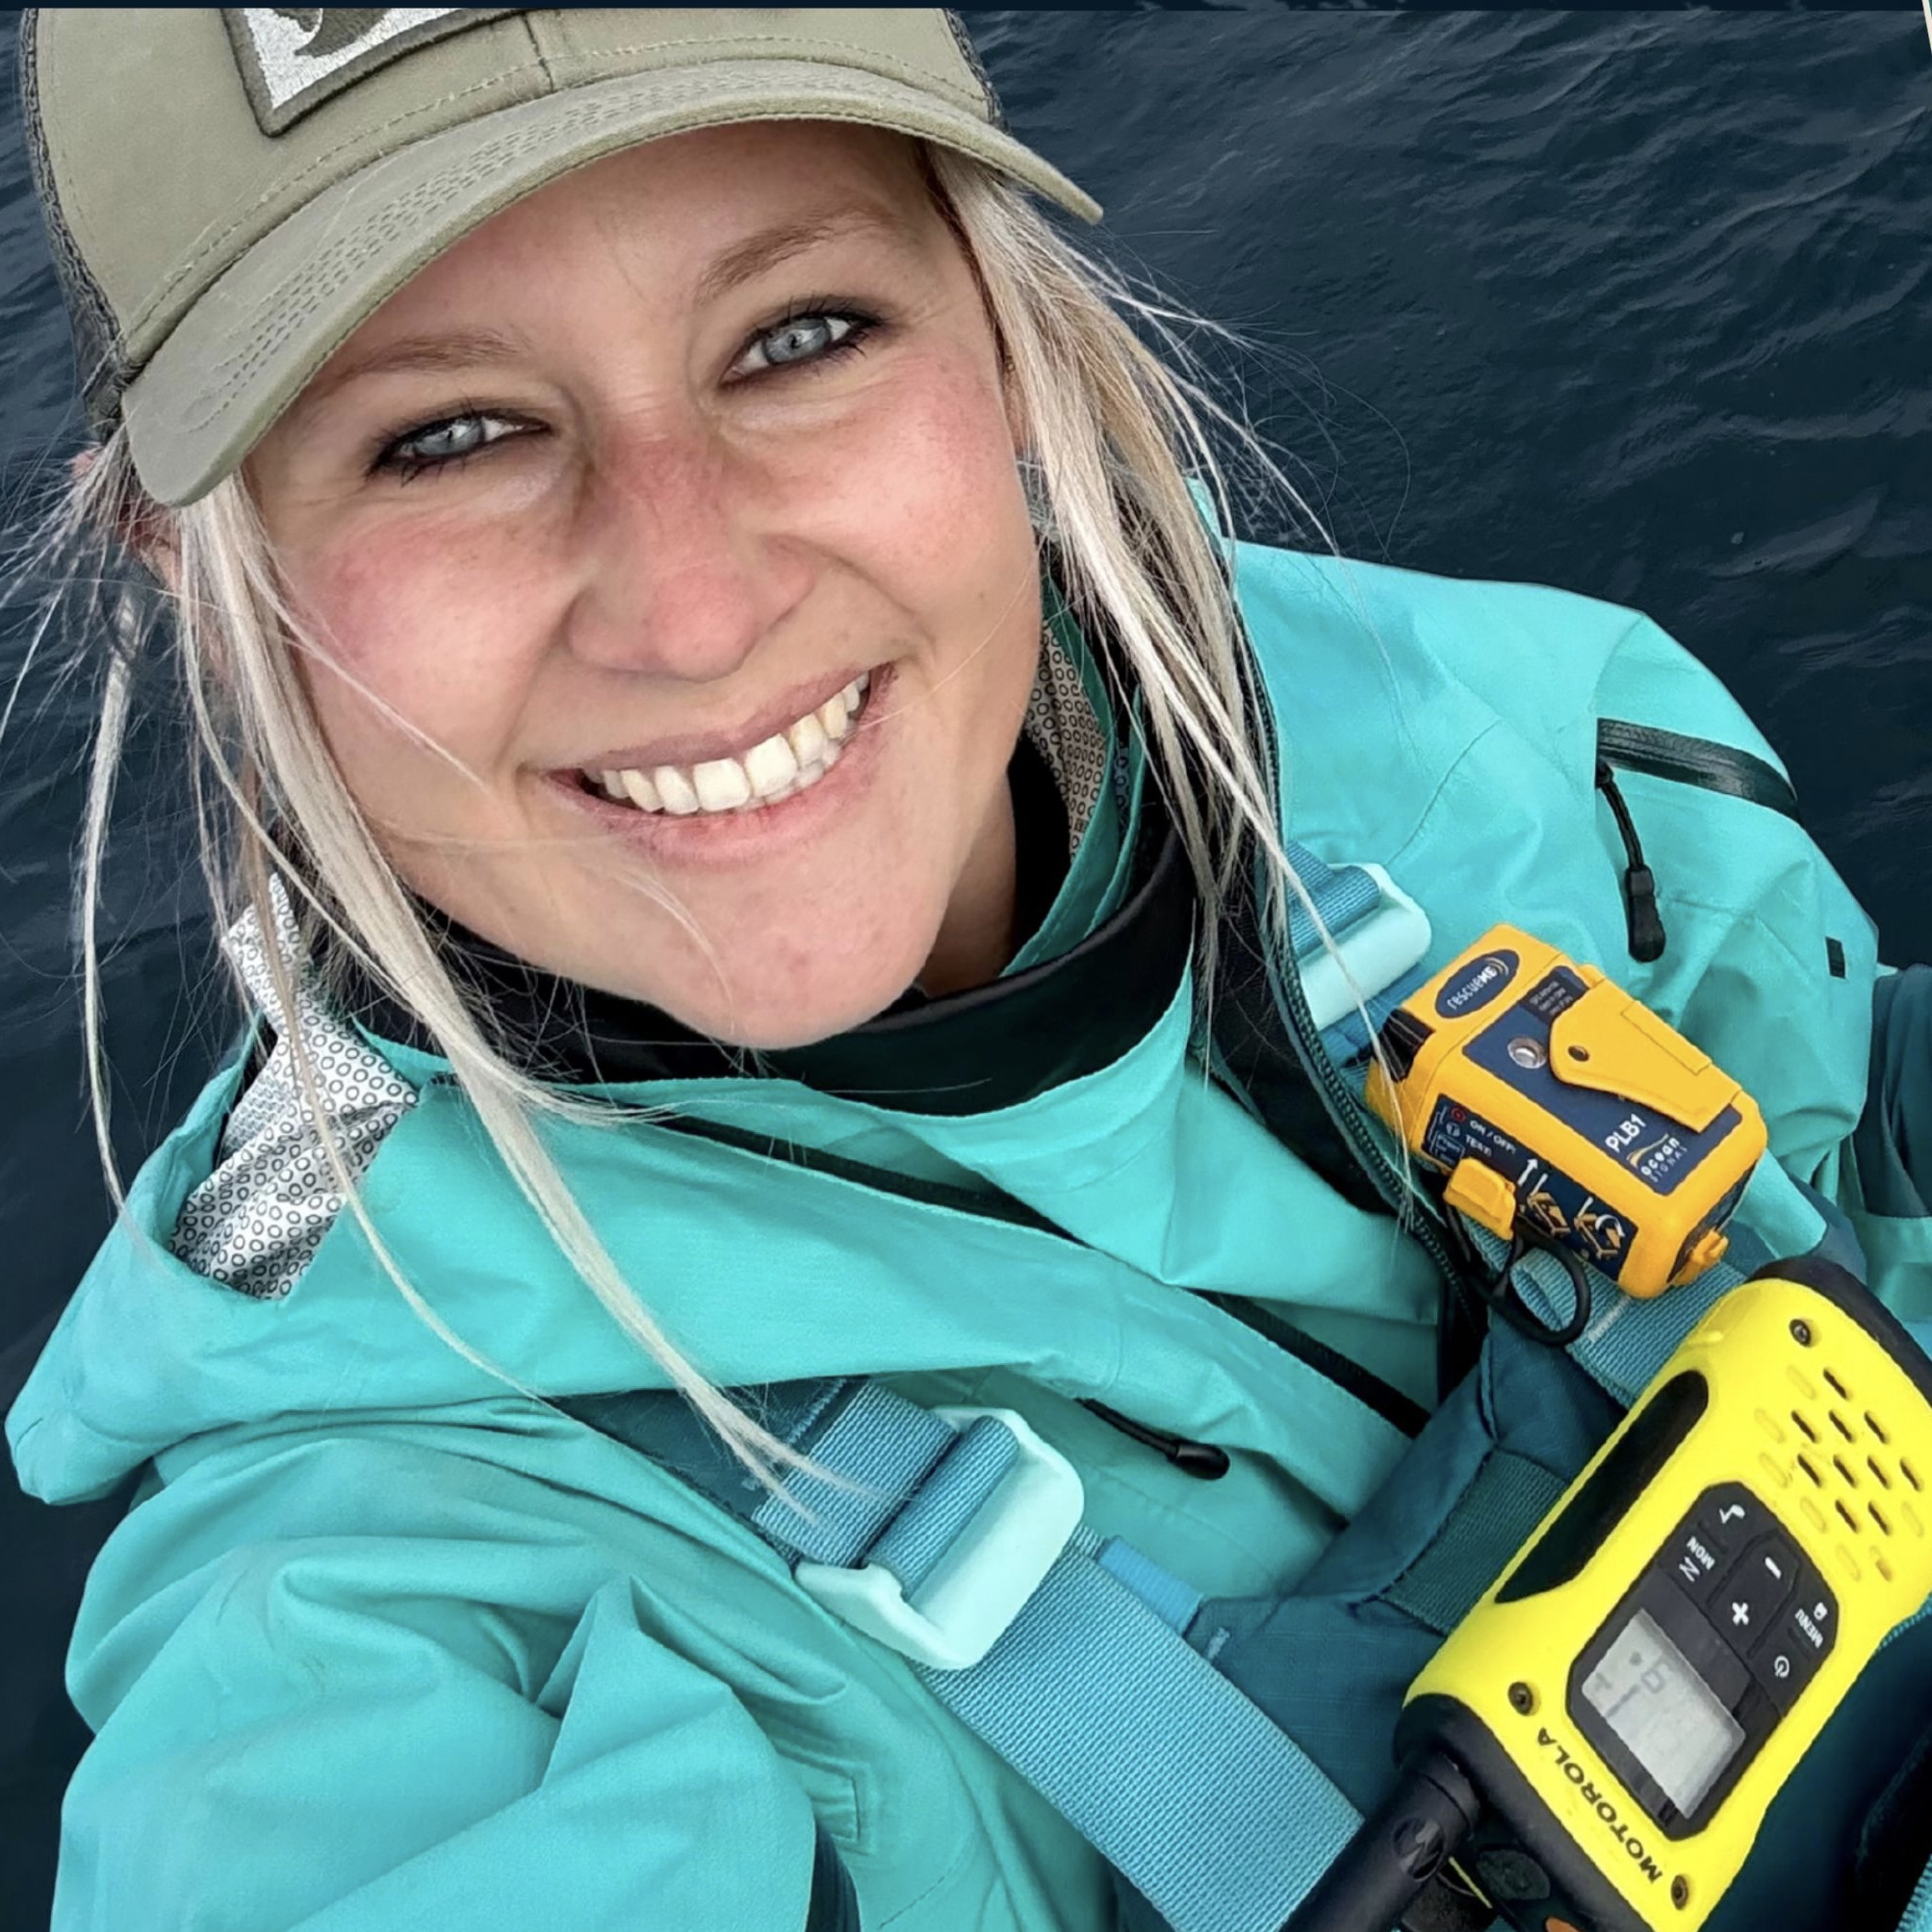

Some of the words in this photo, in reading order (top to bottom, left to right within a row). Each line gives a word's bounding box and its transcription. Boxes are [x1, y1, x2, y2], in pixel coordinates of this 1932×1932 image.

[1447, 966, 1498, 1011] rescueME
[1605, 1114, 1646, 1153] PLB1
[1640, 1137, 1680, 1175] ocean
[1687, 1536, 1715, 1570] MON
[1794, 1609, 1823, 1648] MENU
[1537, 1727, 1662, 1884] MOTOROLA
